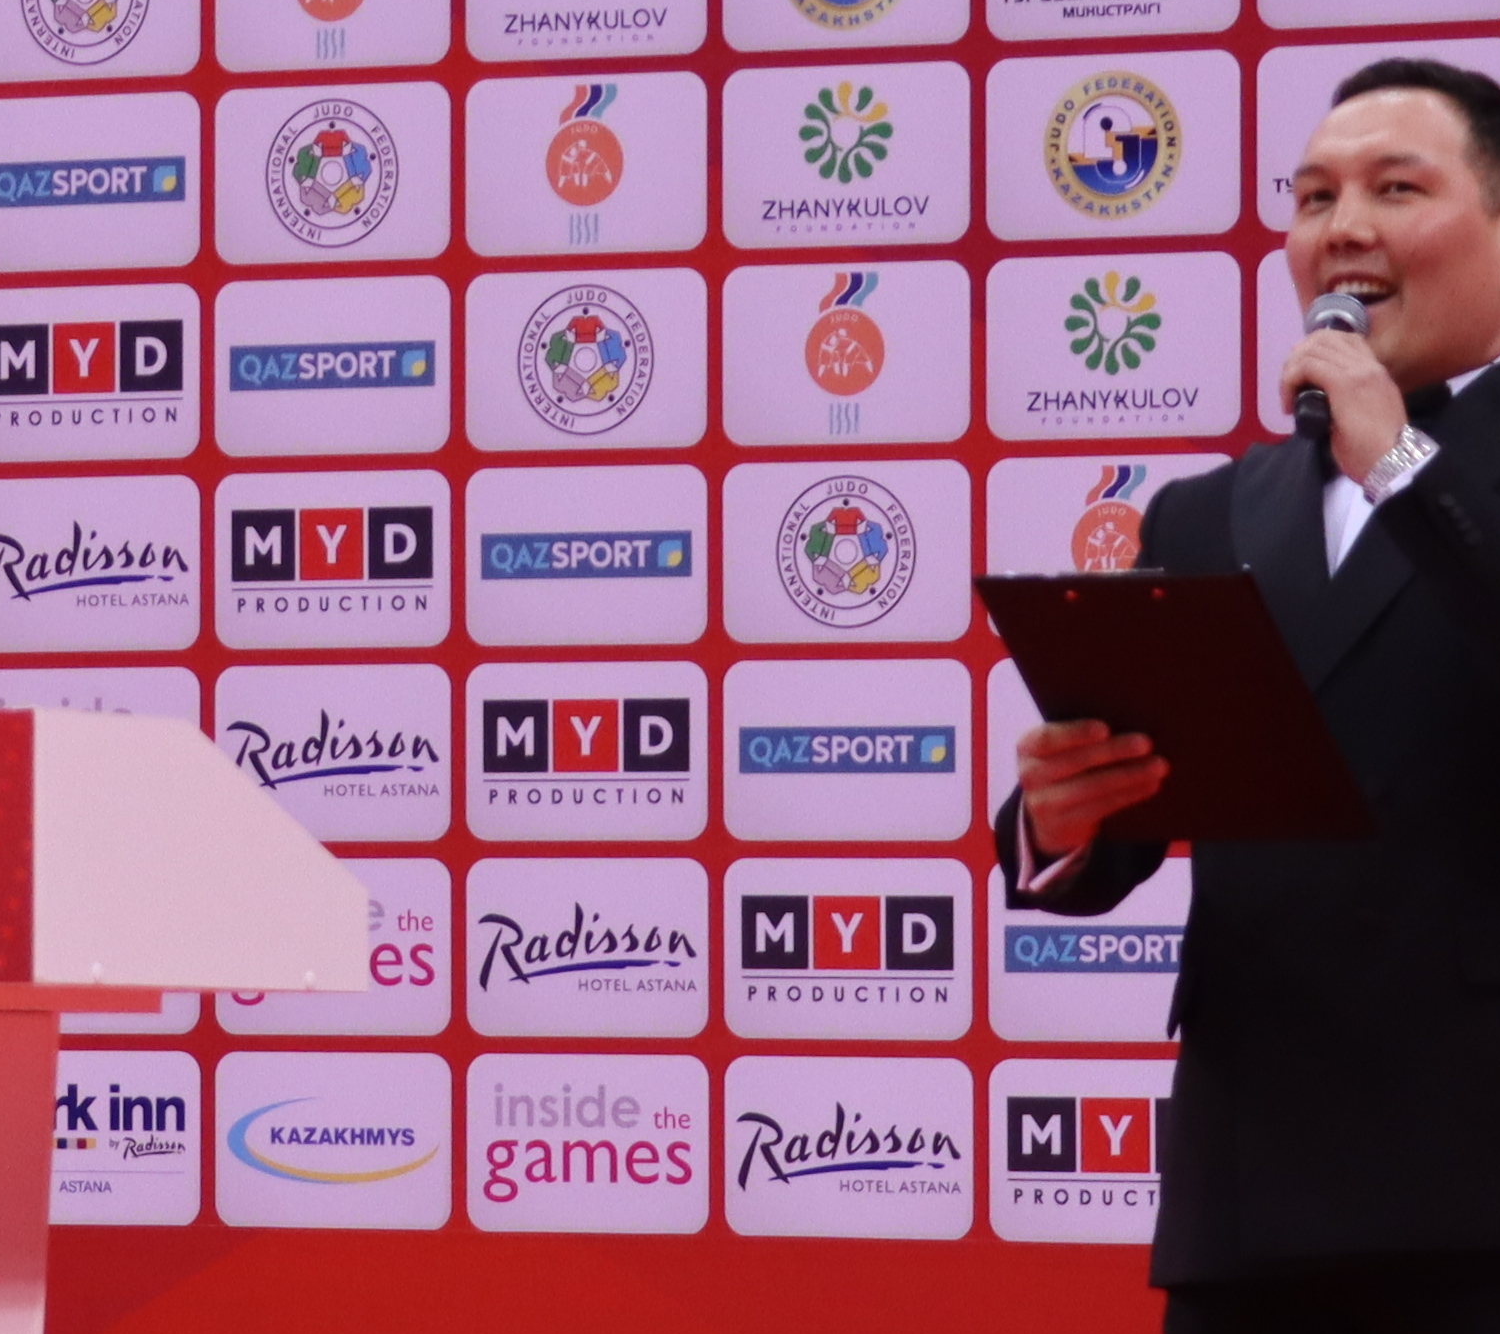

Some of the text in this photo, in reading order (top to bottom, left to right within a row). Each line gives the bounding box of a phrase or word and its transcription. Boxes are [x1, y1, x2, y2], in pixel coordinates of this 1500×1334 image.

[1026, 388, 1199, 412] ZHANYKULOV
[245, 517, 417, 570] MYD
[490, 539, 652, 571] QAZSPORT
[237, 594, 427, 613] PRODUCTION
[494, 1082, 691, 1130] inside the
[270, 1127, 415, 1147] KAZAKHMYS
[737, 1103, 961, 1191] Radisson
[483, 1139, 693, 1203] games
[839, 1179, 961, 1194] HOTEL ASTANA
